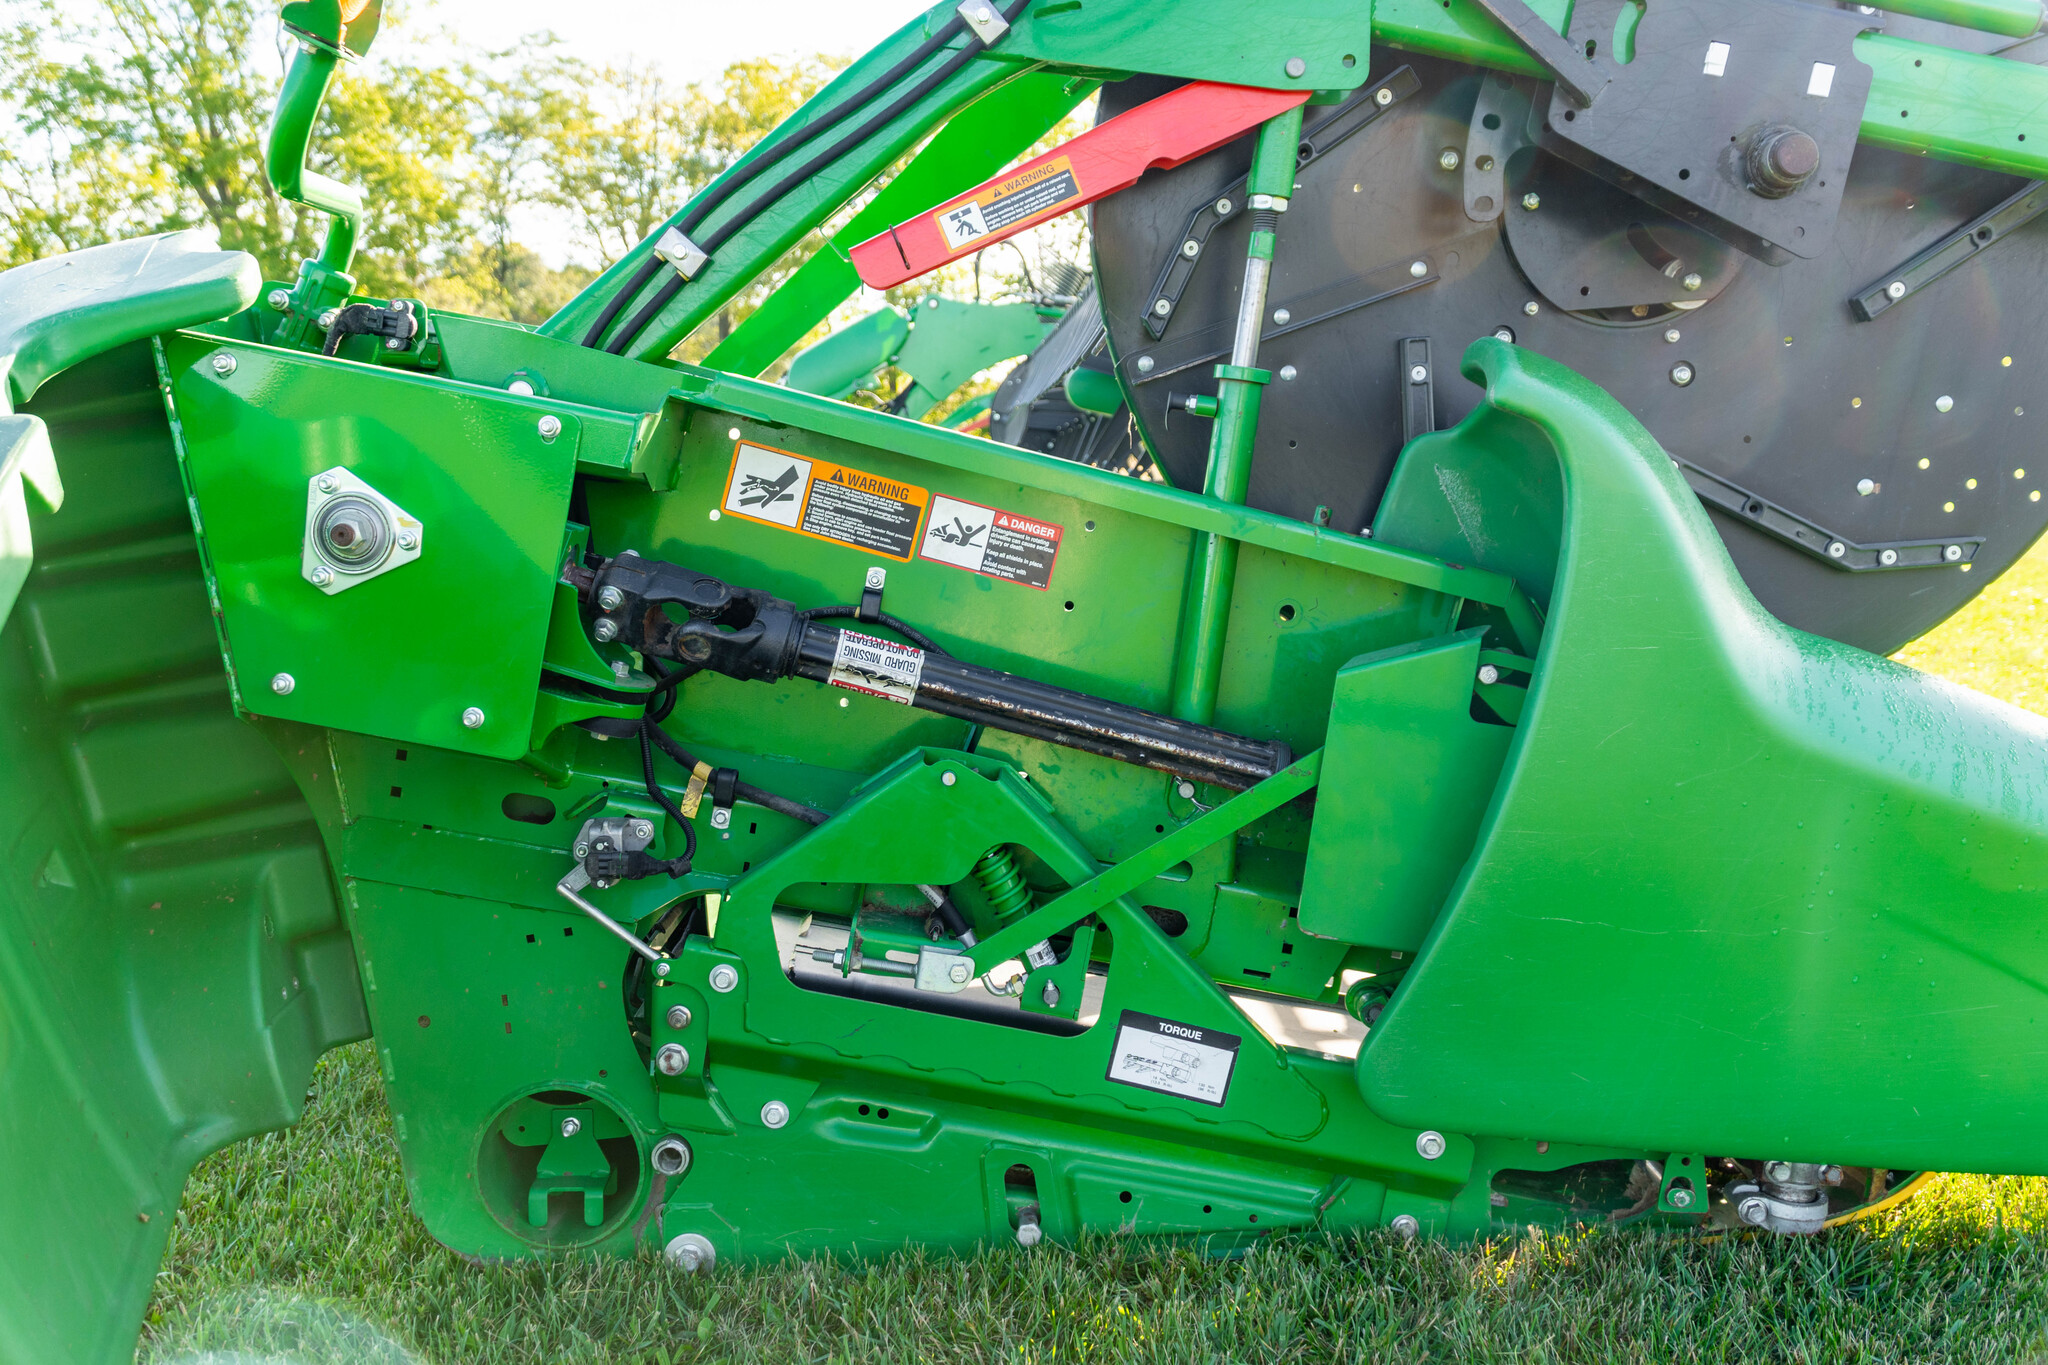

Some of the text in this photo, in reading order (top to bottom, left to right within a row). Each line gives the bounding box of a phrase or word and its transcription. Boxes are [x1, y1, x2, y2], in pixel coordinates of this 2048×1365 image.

[1004, 164, 1055, 192] WARNING
[847, 473, 910, 501] WARNING
[992, 526, 1025, 539] Entanglement
[1030, 538, 1050, 548] rotating
[1010, 518, 1055, 538] DANGER
[989, 538, 1003, 547] injury
[1009, 543, 1024, 551] death.
[990, 532, 1011, 542] driveline
[1036, 545, 1054, 553] serious
[986, 548, 999, 557] Keep
[1006, 554, 1023, 563] shields
[982, 566, 1001, 576] rotating
[997, 564, 1016, 572] contact
[846, 635, 885, 650] OPERATE
[886, 645, 904, 655] NOT
[844, 645, 916, 673] GUARD MISSING
[1158, 1022, 1203, 1041] TORQUE
